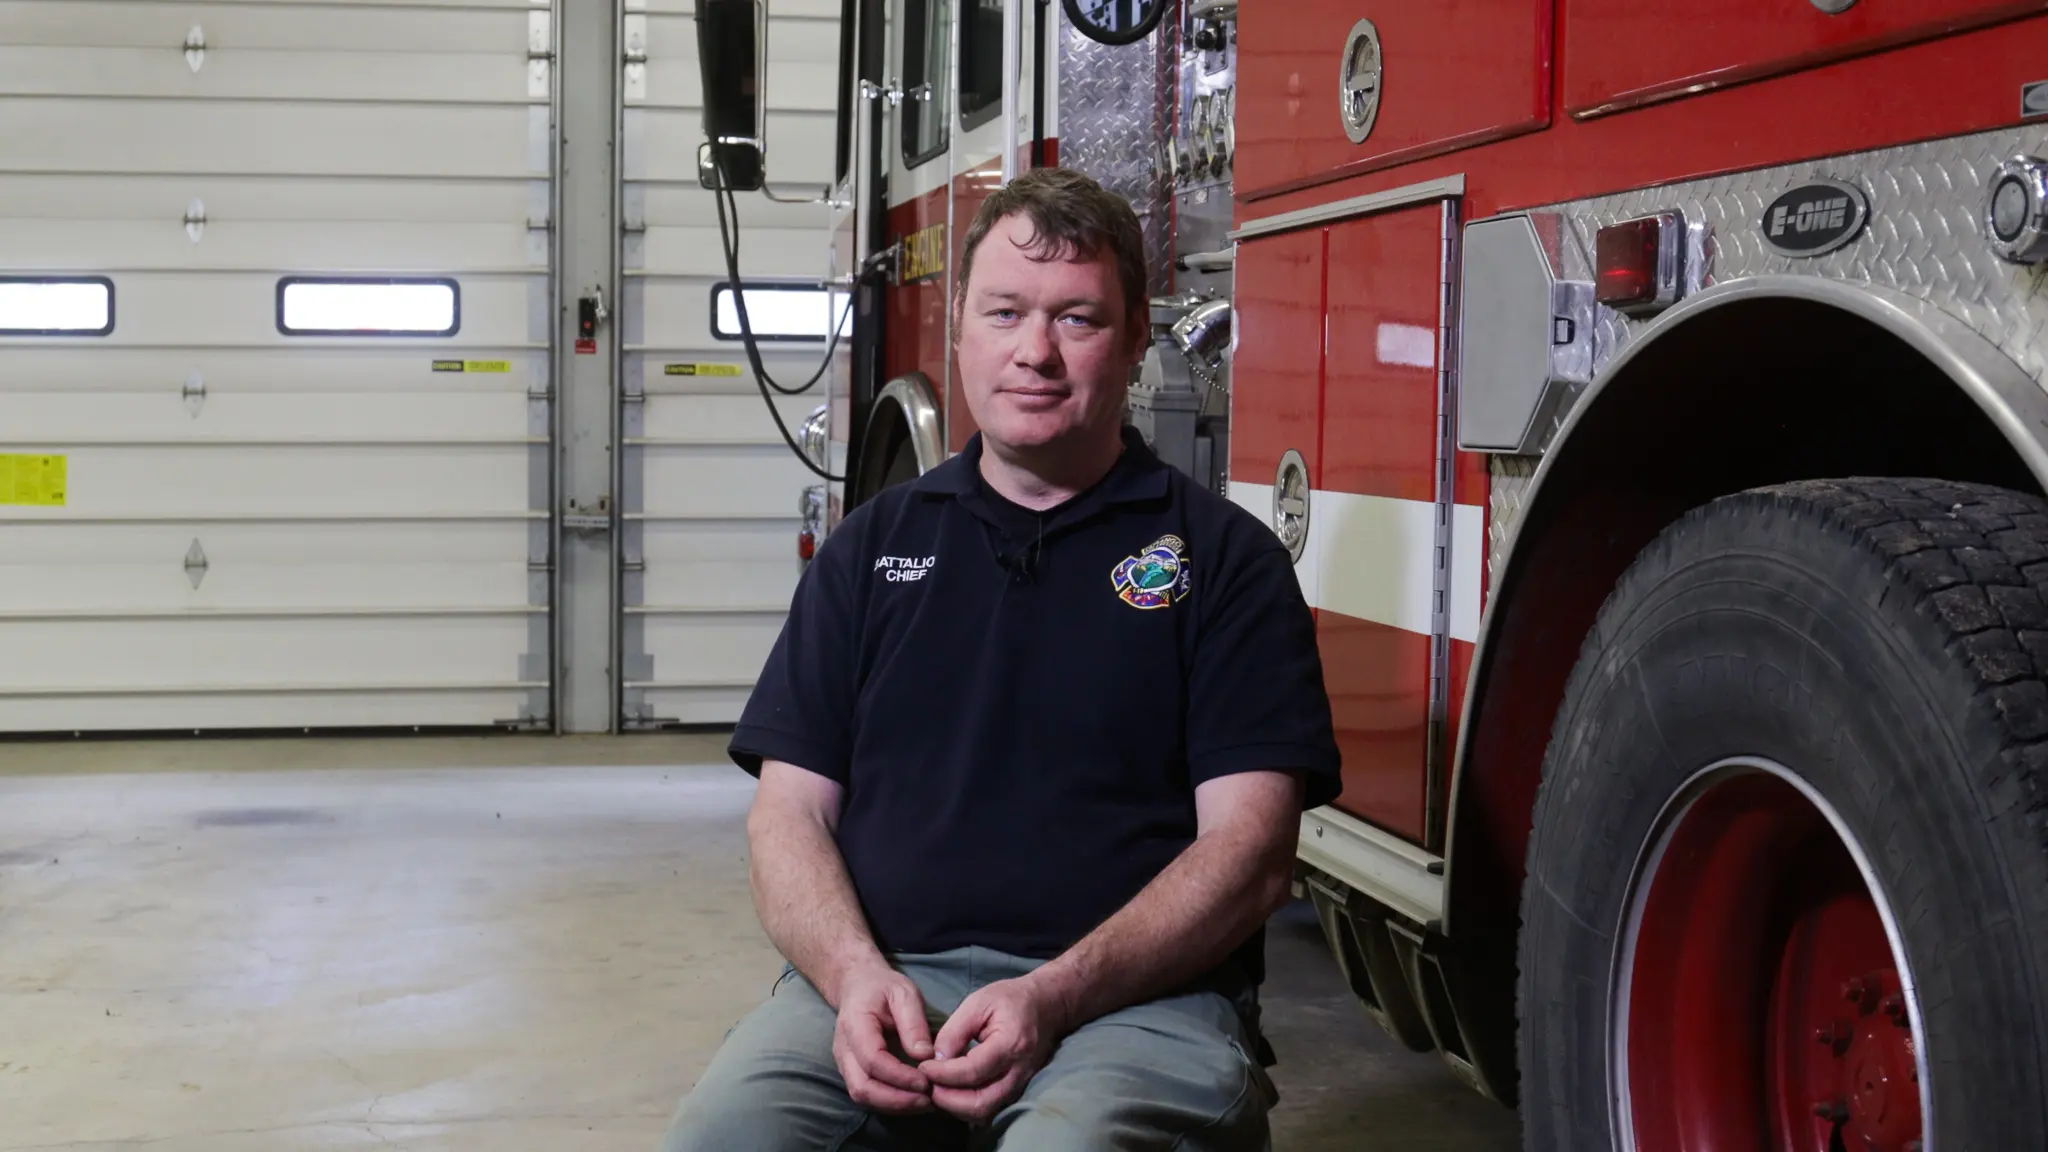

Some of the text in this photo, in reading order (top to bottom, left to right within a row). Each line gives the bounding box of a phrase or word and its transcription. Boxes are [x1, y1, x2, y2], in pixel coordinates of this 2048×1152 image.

[1770, 196, 1849, 237] E-ONE
[904, 223, 944, 280] ENGINE
[885, 568, 928, 582] CHIEF
